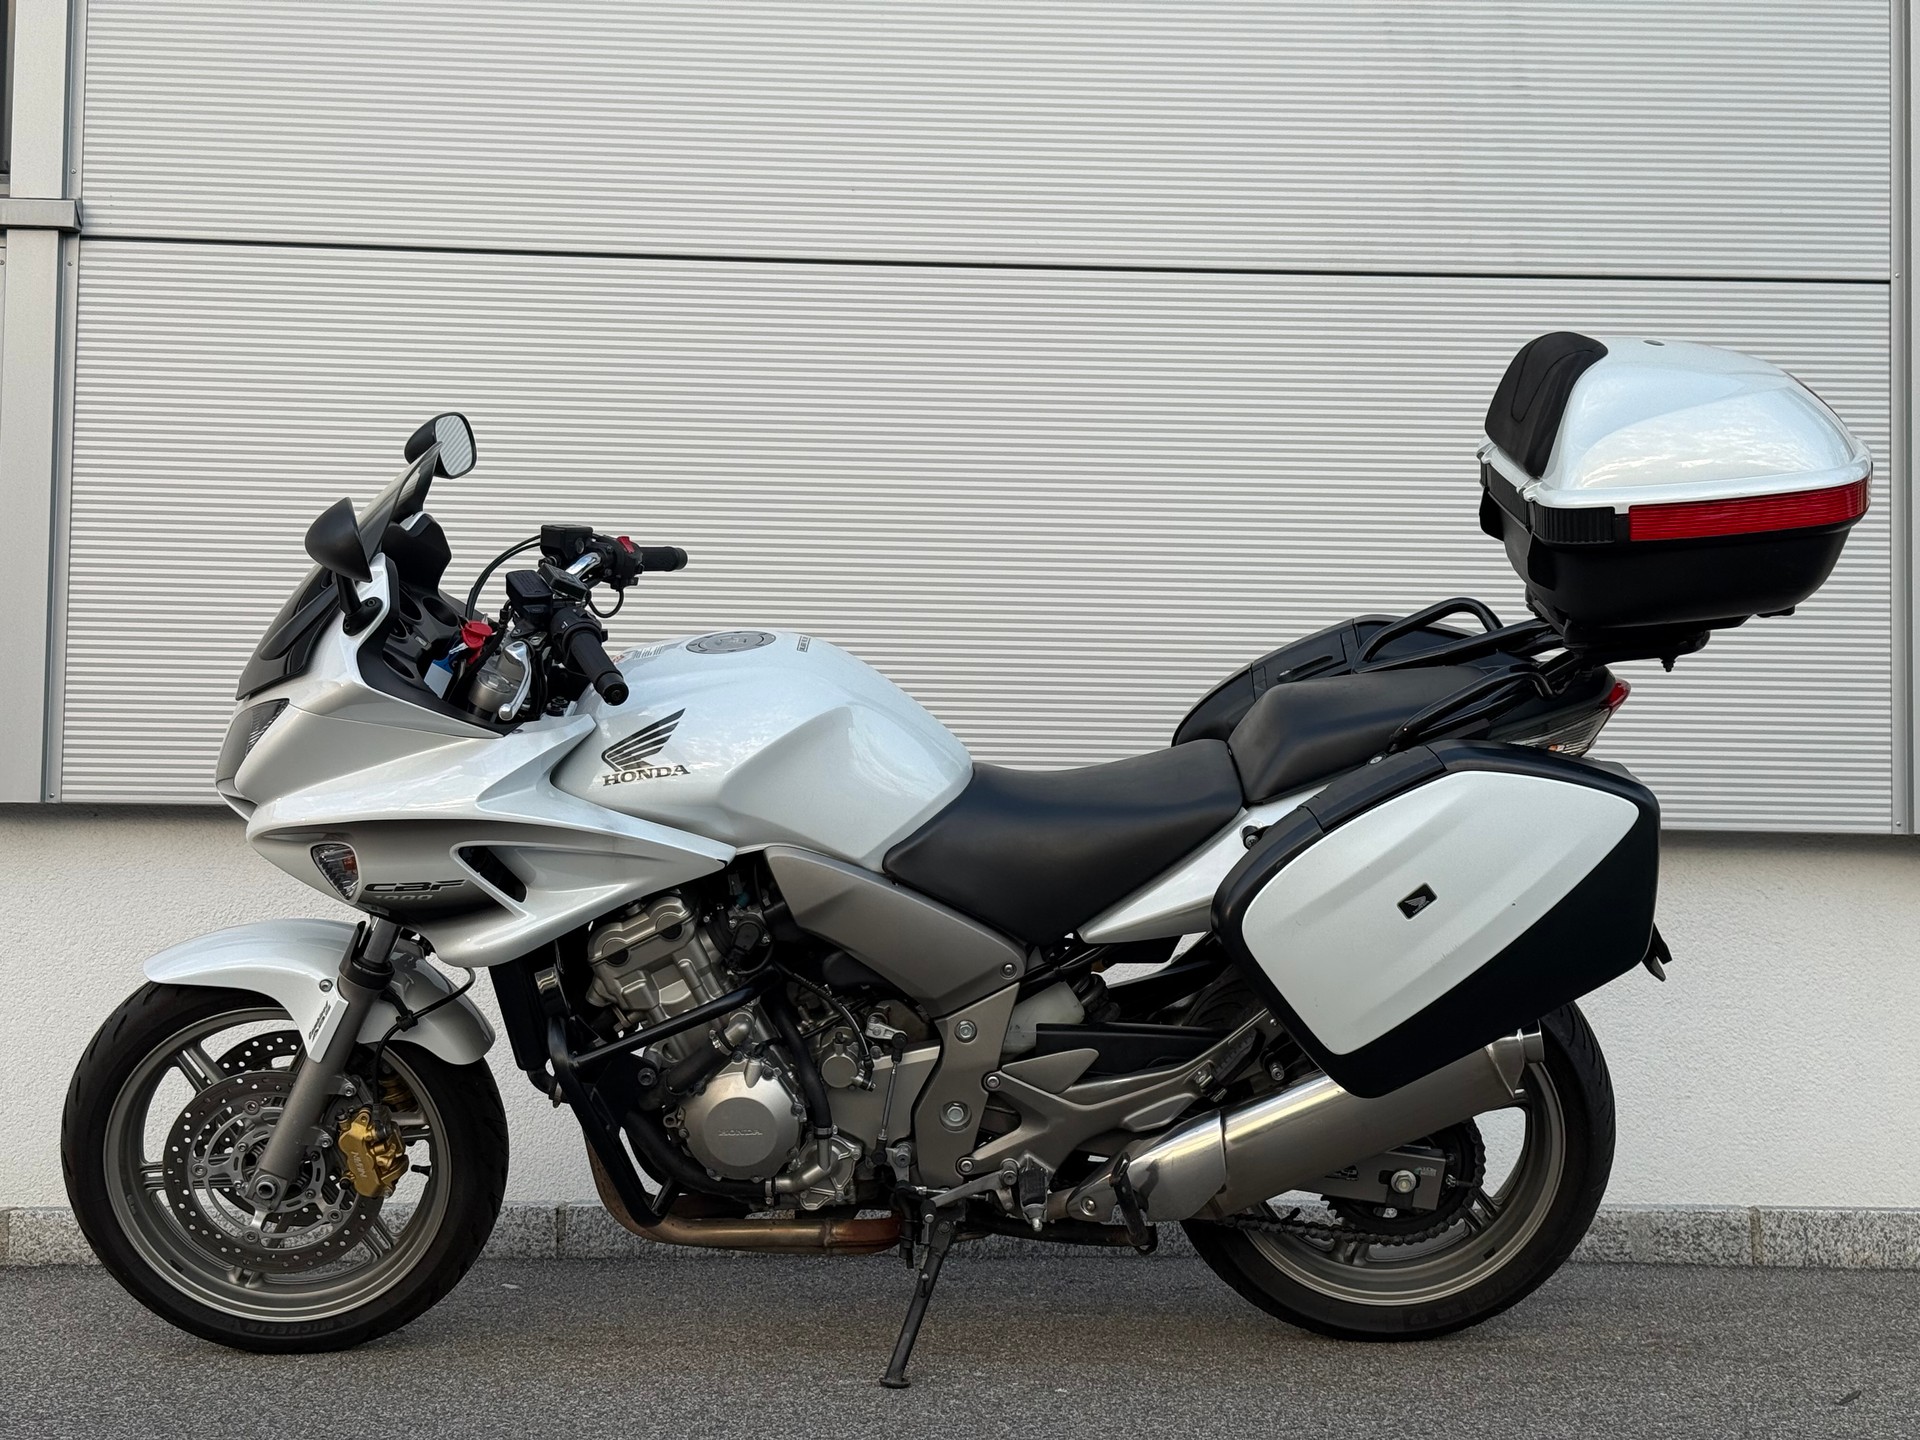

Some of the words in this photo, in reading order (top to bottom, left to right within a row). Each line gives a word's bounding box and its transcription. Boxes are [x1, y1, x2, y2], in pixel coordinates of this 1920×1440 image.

[602, 764, 690, 787] HONDA
[365, 879, 466, 892] CBF
[718, 1129, 763, 1137] HONDA
[244, 1319, 334, 1336] MICHELIN
